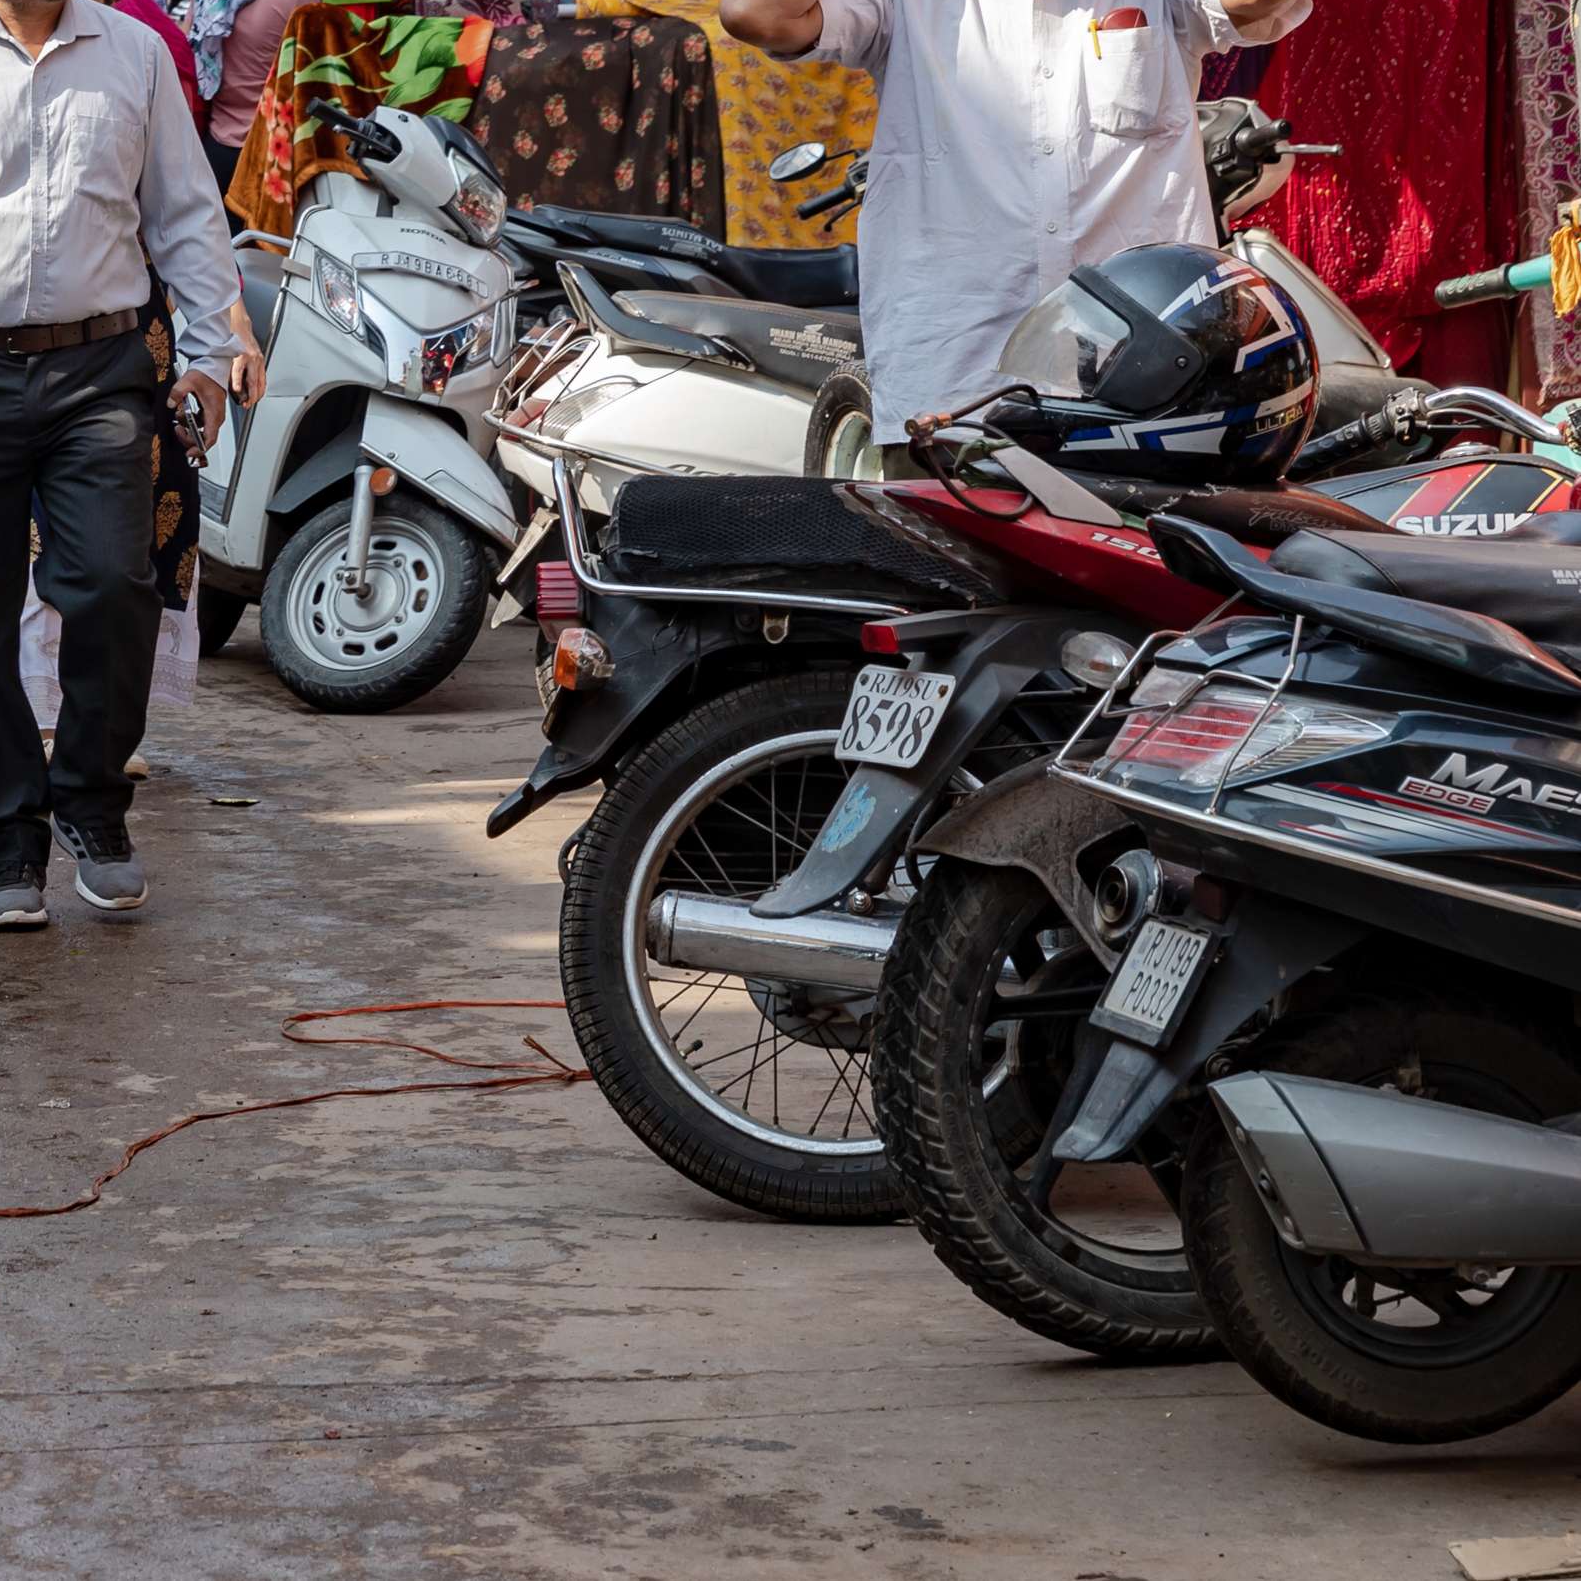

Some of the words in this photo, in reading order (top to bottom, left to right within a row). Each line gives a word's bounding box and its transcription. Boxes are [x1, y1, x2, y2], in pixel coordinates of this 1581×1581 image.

[400, 225, 447, 246] HONDA
[1254, 405, 1304, 434] ULTRA
[868, 669, 934, 703] RJ19SU
[841, 693, 935, 757] 8598
[1403, 780, 1493, 813] EDGE
[1143, 927, 1201, 979] RJ19B
[1123, 970, 1179, 1023] P0332
